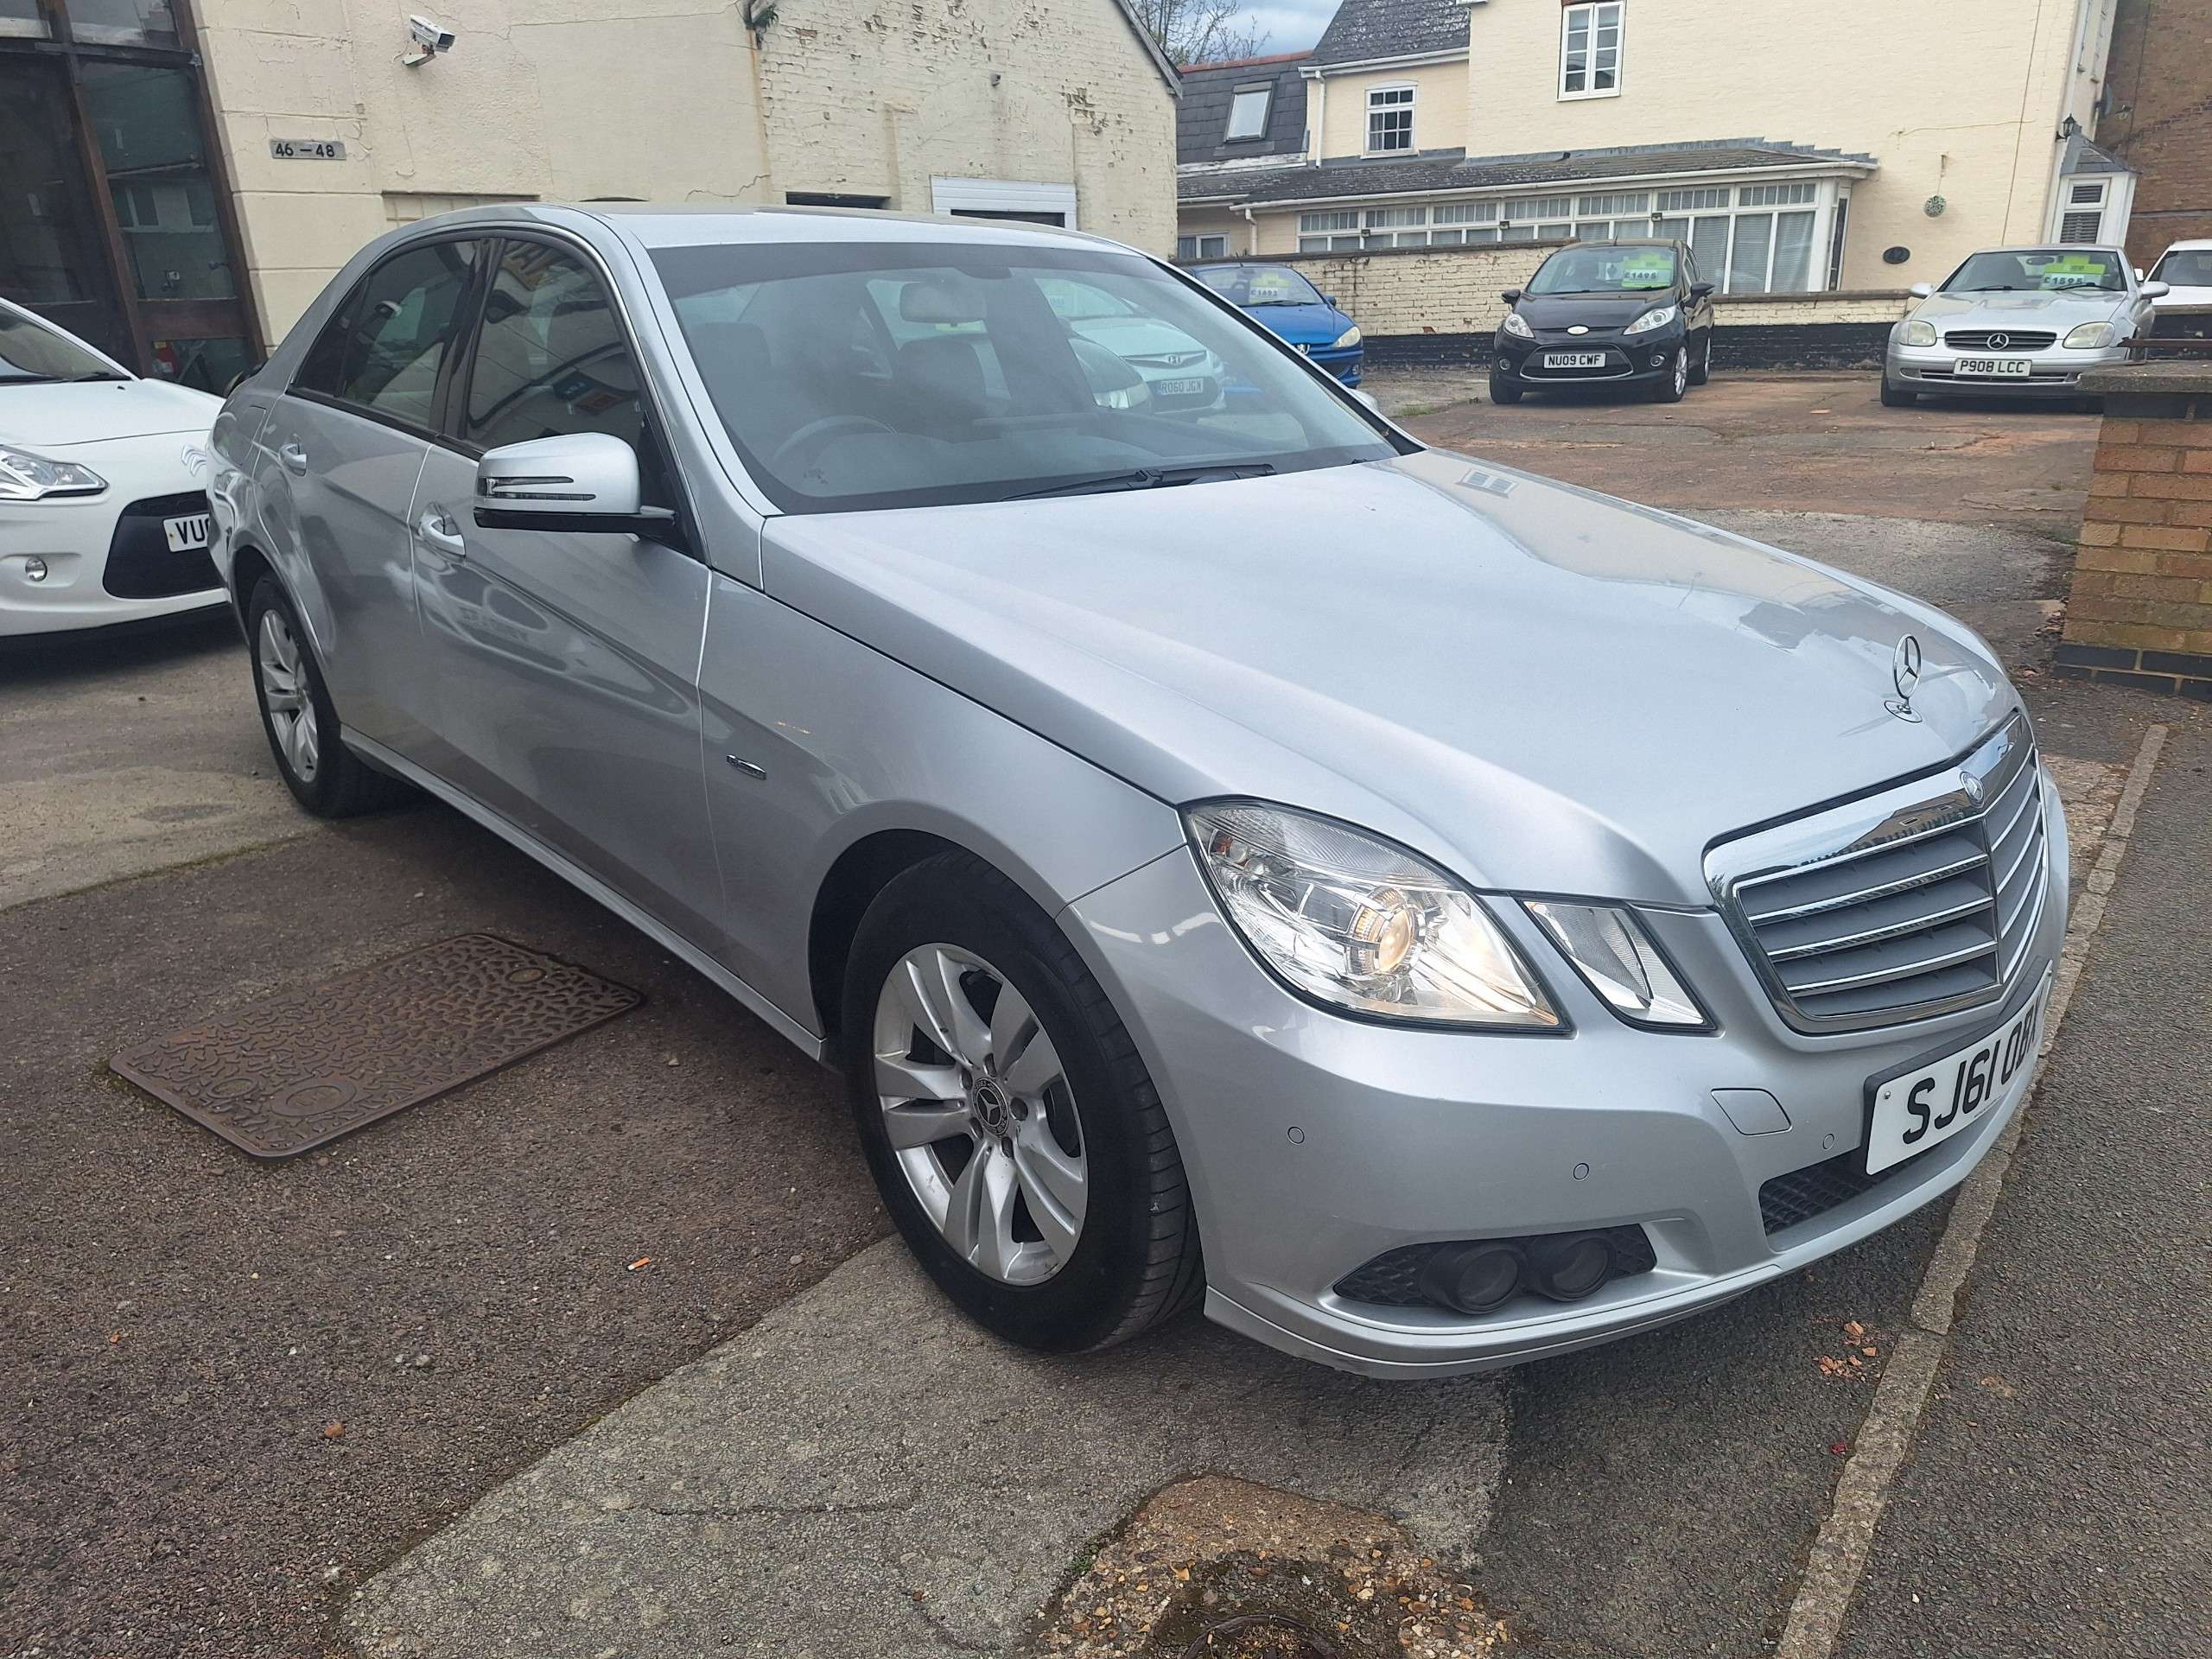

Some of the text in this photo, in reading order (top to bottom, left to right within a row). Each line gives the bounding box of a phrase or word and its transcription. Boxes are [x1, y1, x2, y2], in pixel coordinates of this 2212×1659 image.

[276, 143, 294, 156] 46
[315, 143, 334, 157] 48
[1548, 355, 1601, 365] NU09 CWF
[1960, 360, 2025, 372] P908 LCC
[1903, 1039, 2001, 1145] SJ61
